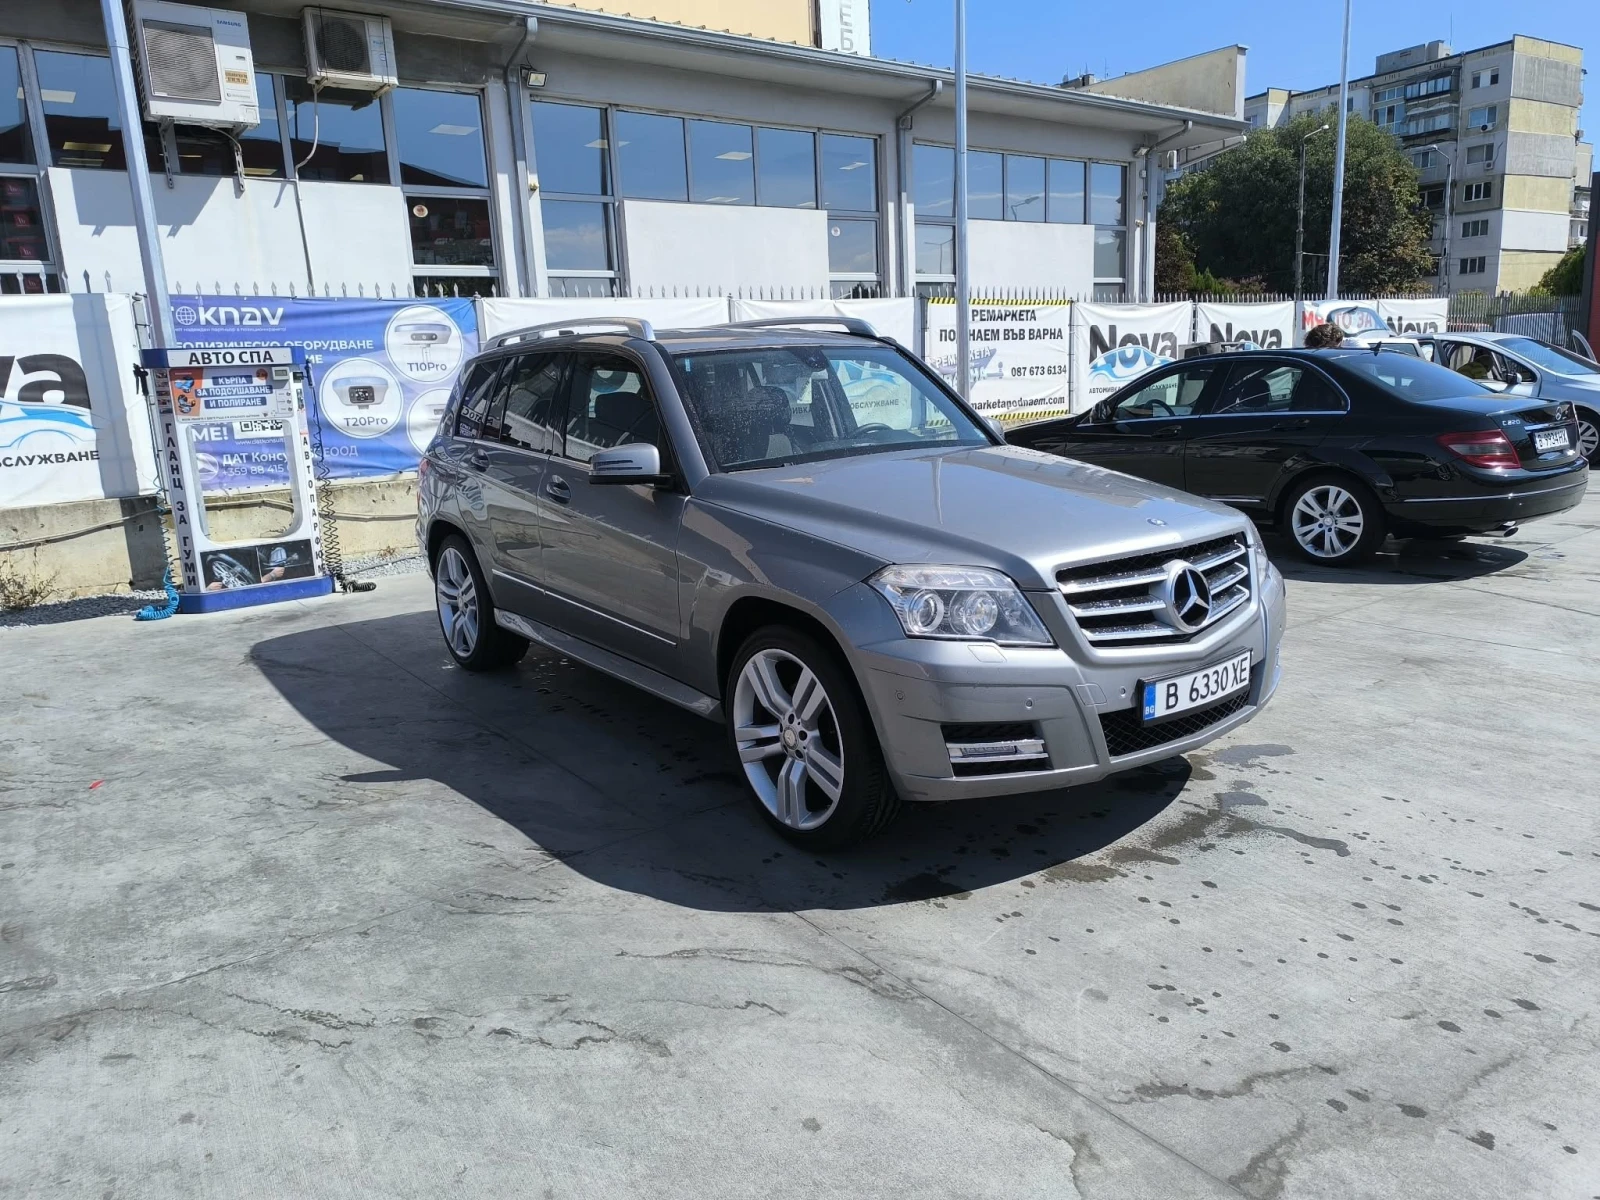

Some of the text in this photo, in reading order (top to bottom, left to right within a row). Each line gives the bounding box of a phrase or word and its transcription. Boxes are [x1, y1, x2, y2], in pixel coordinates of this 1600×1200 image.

[971, 309, 1036, 322] РЕМАРКЕТА
[1387, 315, 1439, 335] Nova
[939, 328, 1063, 343] ПО НАЕМ ВЪВ ВАРНА
[1209, 322, 1283, 349] Nova
[1089, 325, 1177, 366] Nova
[188, 350, 275, 365] АВТО СПА
[936, 347, 991, 368] РЕМКЕТА
[407, 362, 447, 372] T10Pro
[1011, 364, 1067, 377] 087 673 6134
[218, 377, 248, 385] КЪРПА
[196, 386, 271, 397] ЗА ПОДСУШАВАНЕ
[209, 398, 262, 408] И ПОЛИРАНЕ
[970, 396, 1065, 412] marketapodnaem.com
[344, 417, 388, 427] T20Pro
[0, 450, 100, 468] СЛУЖВАНЕ
[222, 453, 249, 466] ДАТ
[252, 451, 288, 464] Консу
[324, 445, 358, 457] ЕООД
[250, 467, 265, 475] 88
[267, 465, 285, 474] 415
[165, 423, 197, 586] ГЛАНЦ ЗА ГУМИ
[1165, 682, 1179, 710] B
[1189, 666, 1229, 702] 6330
[1145, 706, 1155, 715] BG
